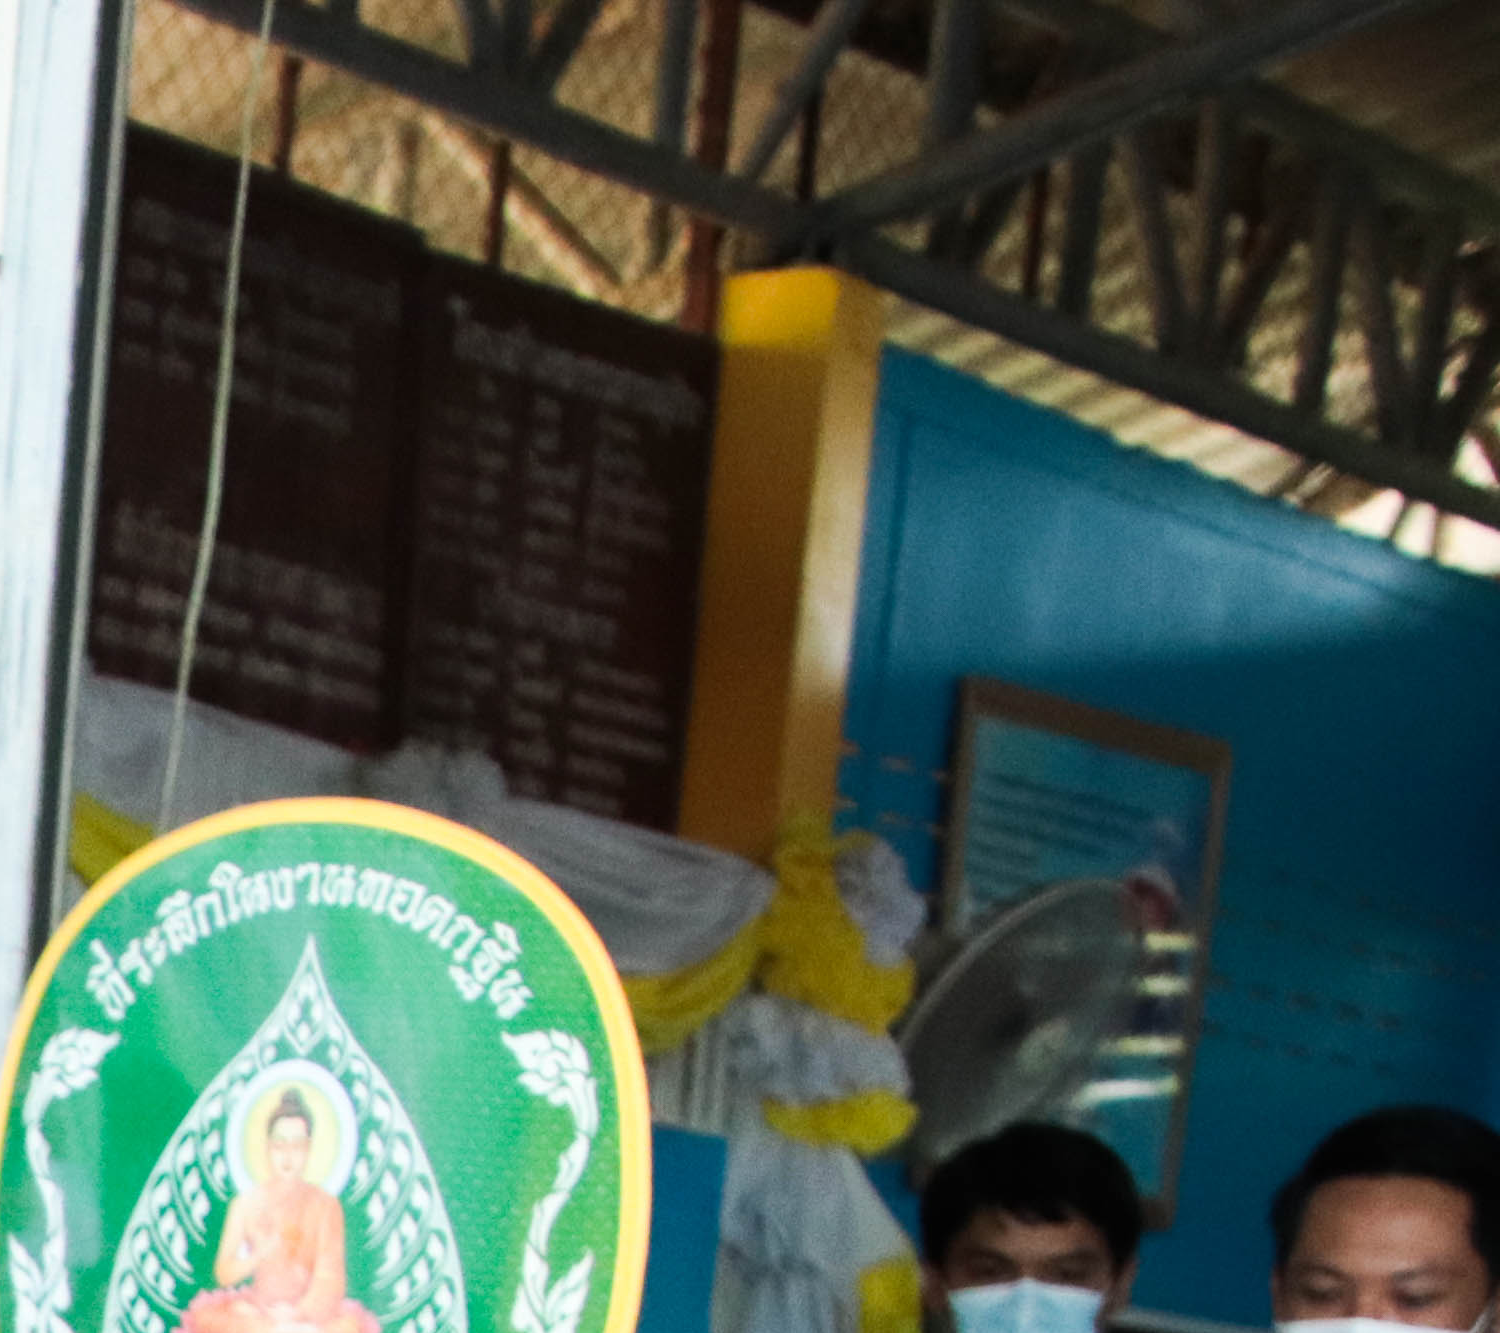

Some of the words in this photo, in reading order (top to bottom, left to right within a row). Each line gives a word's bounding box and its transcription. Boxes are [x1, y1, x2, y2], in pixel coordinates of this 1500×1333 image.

[84, 859, 534, 1022] ที่ระลึกในงานทอดกฐิน
